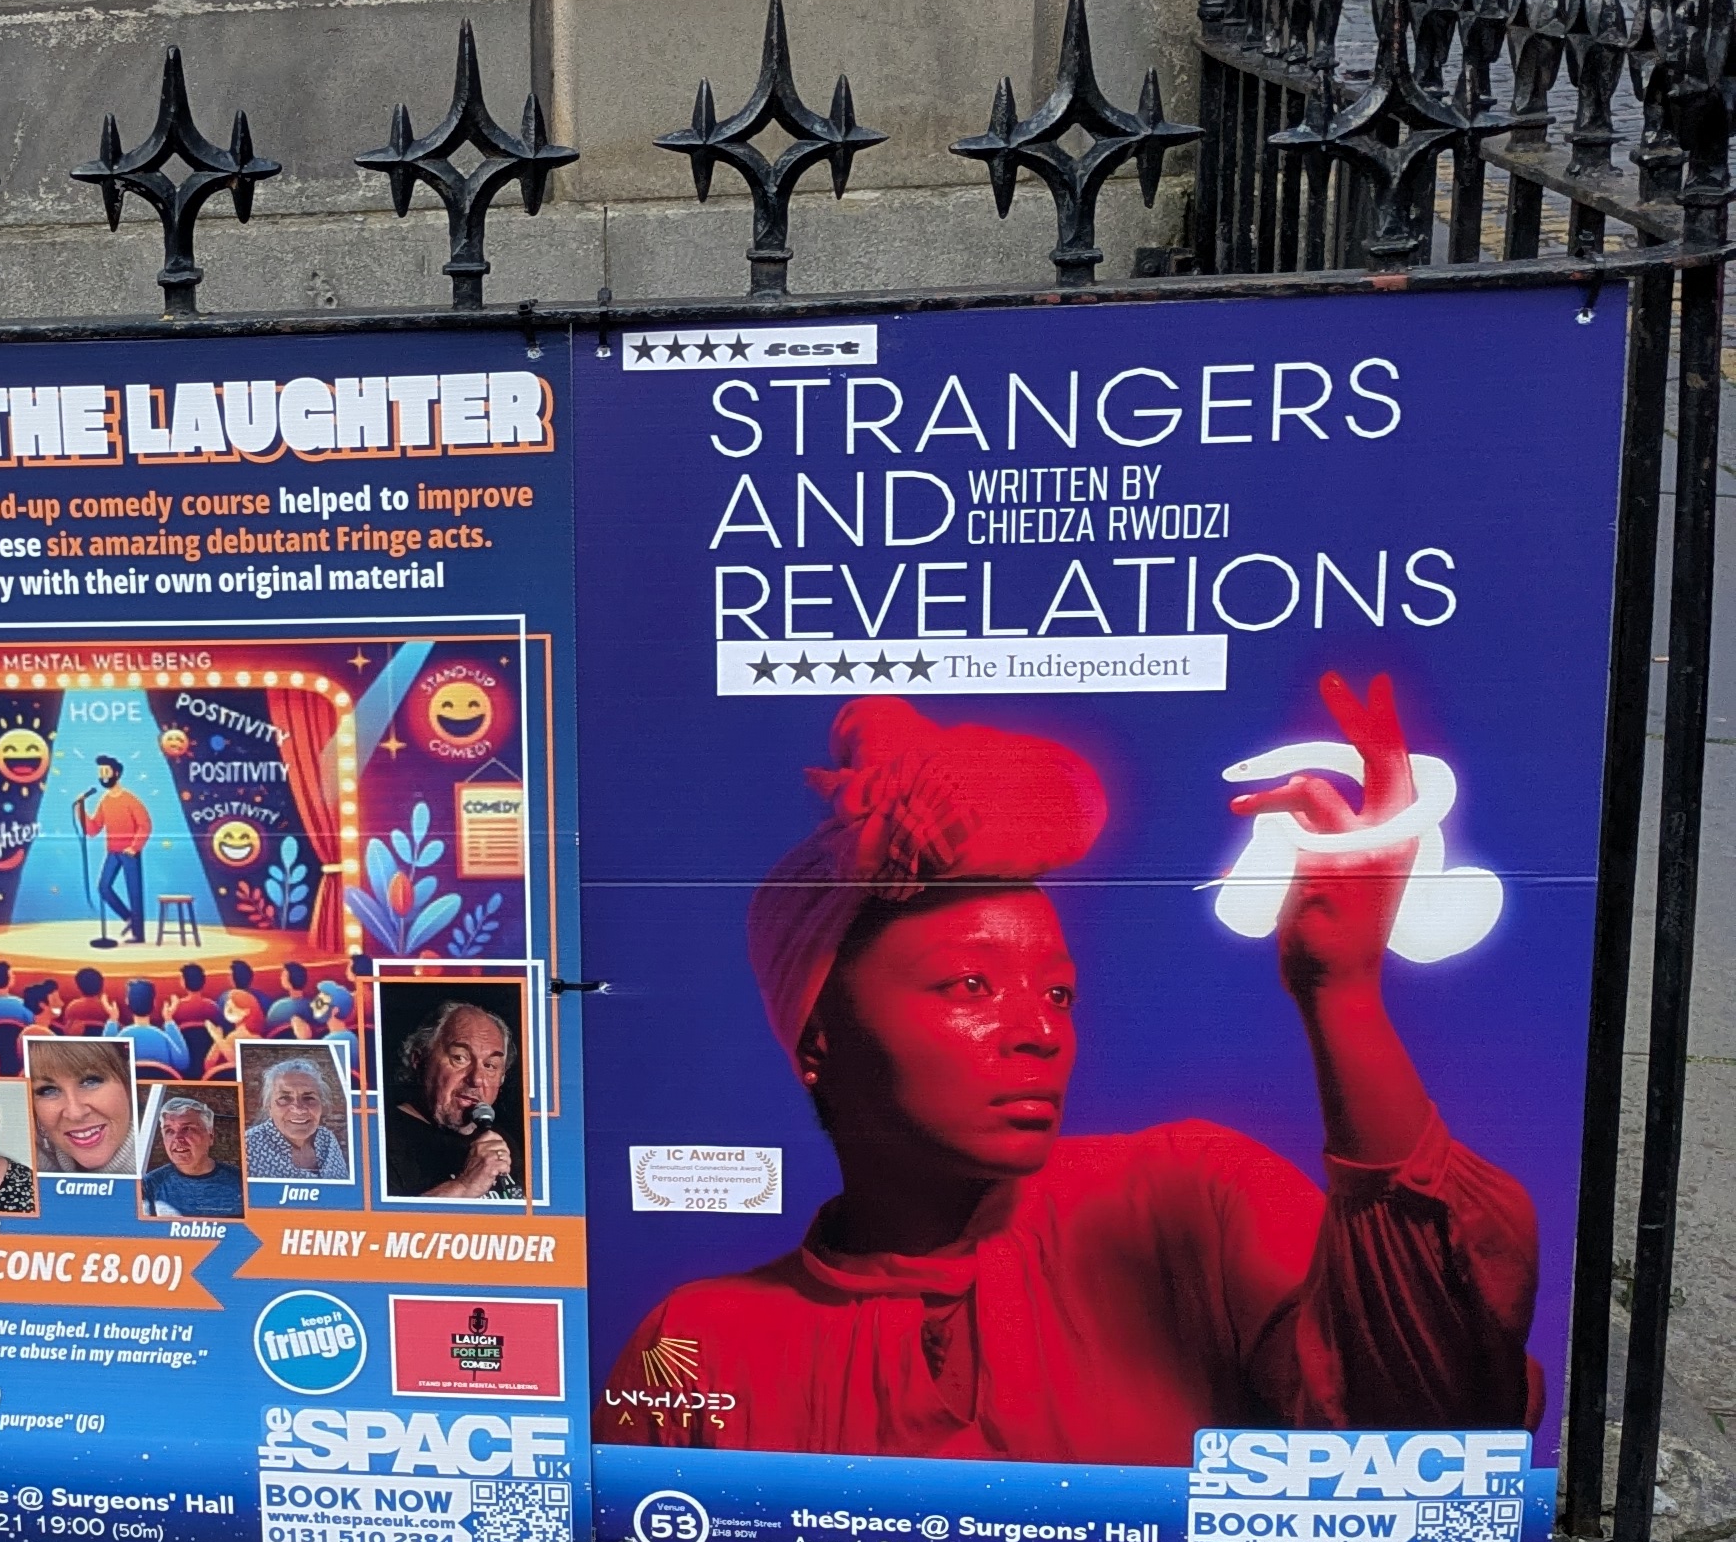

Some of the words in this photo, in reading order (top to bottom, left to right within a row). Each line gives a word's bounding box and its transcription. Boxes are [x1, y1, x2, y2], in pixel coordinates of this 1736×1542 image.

[764, 338, 861, 358] fest
[126, 371, 542, 453] LAUGHTER
[710, 357, 1402, 458] STRANGERS
[968, 467, 1107, 504] WRITTEN
[1123, 465, 1161, 500] BY
[69, 491, 172, 522] comedy
[182, 495, 270, 515] course
[280, 485, 370, 519] helped
[380, 488, 408, 510] to
[419, 483, 532, 516] improve
[709, 470, 956, 550] AND
[968, 508, 1094, 544] CHIEDZA
[1109, 504, 1229, 541] RWODZI
[47, 531, 83, 556] six
[89, 530, 201, 561] amazing
[207, 529, 330, 554] debutant
[337, 527, 421, 557] Fringe
[428, 526, 492, 548] acts.
[20, 569, 79, 595] with
[85, 568, 149, 594] their
[156, 573, 212, 593] own
[219, 565, 322, 599] original
[329, 564, 443, 590] material
[716, 547, 1458, 640] REVELATIONS
[2, 653, 86, 672] MENTAL
[944, 655, 996, 677] The
[1007, 653, 1190, 683] Indiependent
[70, 701, 142, 723] HOPE
[429, 739, 492, 759] COMEDY
[189, 761, 290, 783] POSITIVITY
[191, 801, 280, 825] POSITIVITY
[667, 1149, 683, 1160] IC
[690, 1150, 744, 1161] Award
[56, 1178, 114, 1196] Carmel
[652, 1174, 694, 1183] Personal
[697, 1174, 762, 1184] Achievement
[280, 1184, 320, 1204] Jane
[685, 1197, 728, 1210] 2025
[170, 1221, 227, 1239] Robbie
[282, 1229, 366, 1256] HENRY
[385, 1232, 555, 1261] MC/FOUNDER
[81, 1253, 182, 1290] £8.00)
[301, 1313, 332, 1329] keep
[333, 1311, 343, 1323] it
[264, 1322, 357, 1361] fringe
[455, 1334, 497, 1346] LAUGH
[453, 1348, 476, 1358] FOR
[477, 1348, 500, 1358] LIFE
[461, 1360, 501, 1370] COMEDY
[605, 1389, 736, 1410] UNSHADED
[657, 1503, 685, 1512] Venue
[651, 1514, 698, 1540] 53
[754, 1519, 781, 1528] Street
[791, 1509, 911, 1534] theSpace
[920, 1516, 951, 1540] @
[1106, 1523, 1158, 1542] Hall
[1194, 1512, 1298, 1537] BOOK
[1313, 1514, 1397, 1538] NOW
